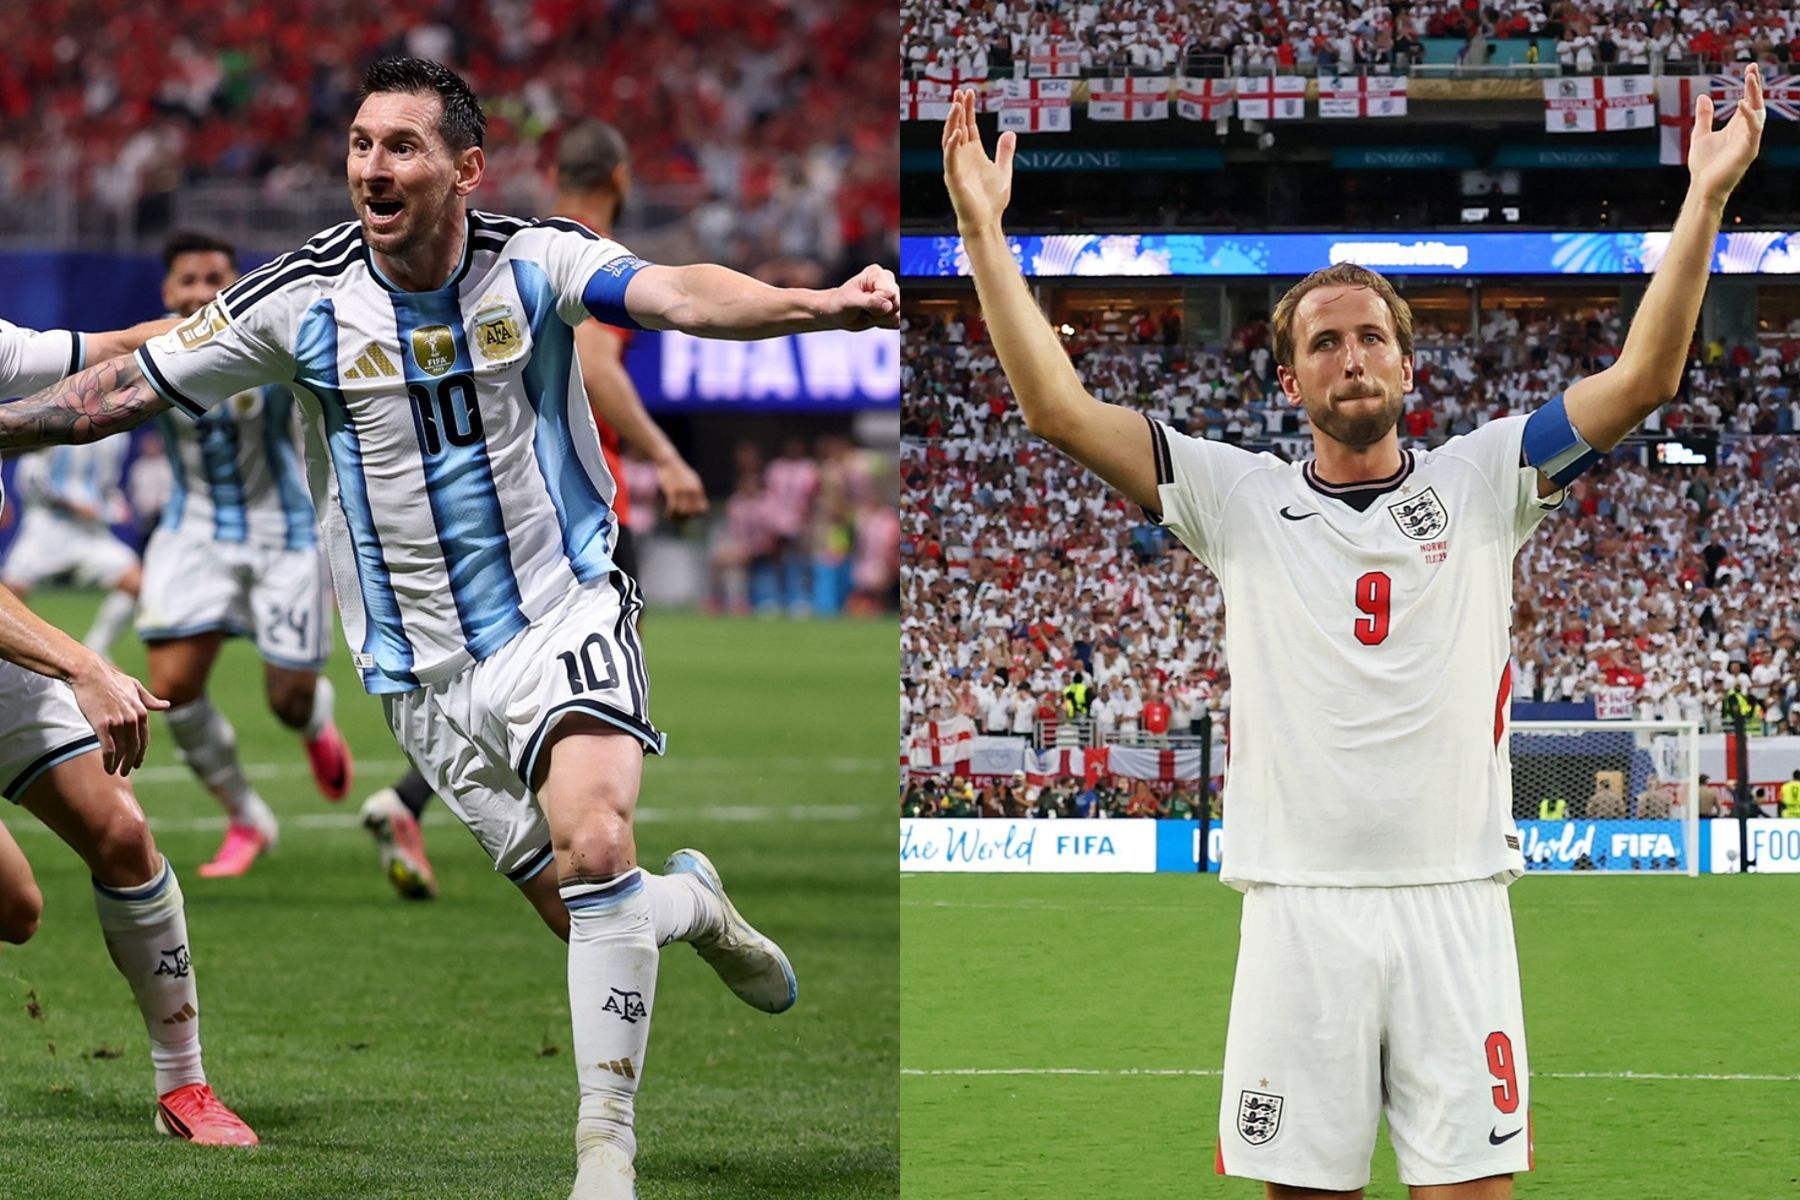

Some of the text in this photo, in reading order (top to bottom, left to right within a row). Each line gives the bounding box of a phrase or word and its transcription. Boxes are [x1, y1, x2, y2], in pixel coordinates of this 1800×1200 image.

[1014, 151, 1121, 168] NDZONE
[1364, 151, 1445, 163] ENDZONE
[1538, 151, 1620, 163] ENDZONE
[486, 320, 513, 345] AFA
[427, 356, 447, 366] FIFA
[408, 374, 486, 457] 10
[1354, 571, 1392, 646] 9
[266, 604, 309, 651] 24
[556, 632, 621, 696] 10
[947, 825, 1036, 866] World
[1056, 836, 1116, 855] FIFA
[1611, 833, 1676, 858] FIFA
[601, 987, 648, 1024] AFA
[1484, 1031, 1520, 1115] 9
